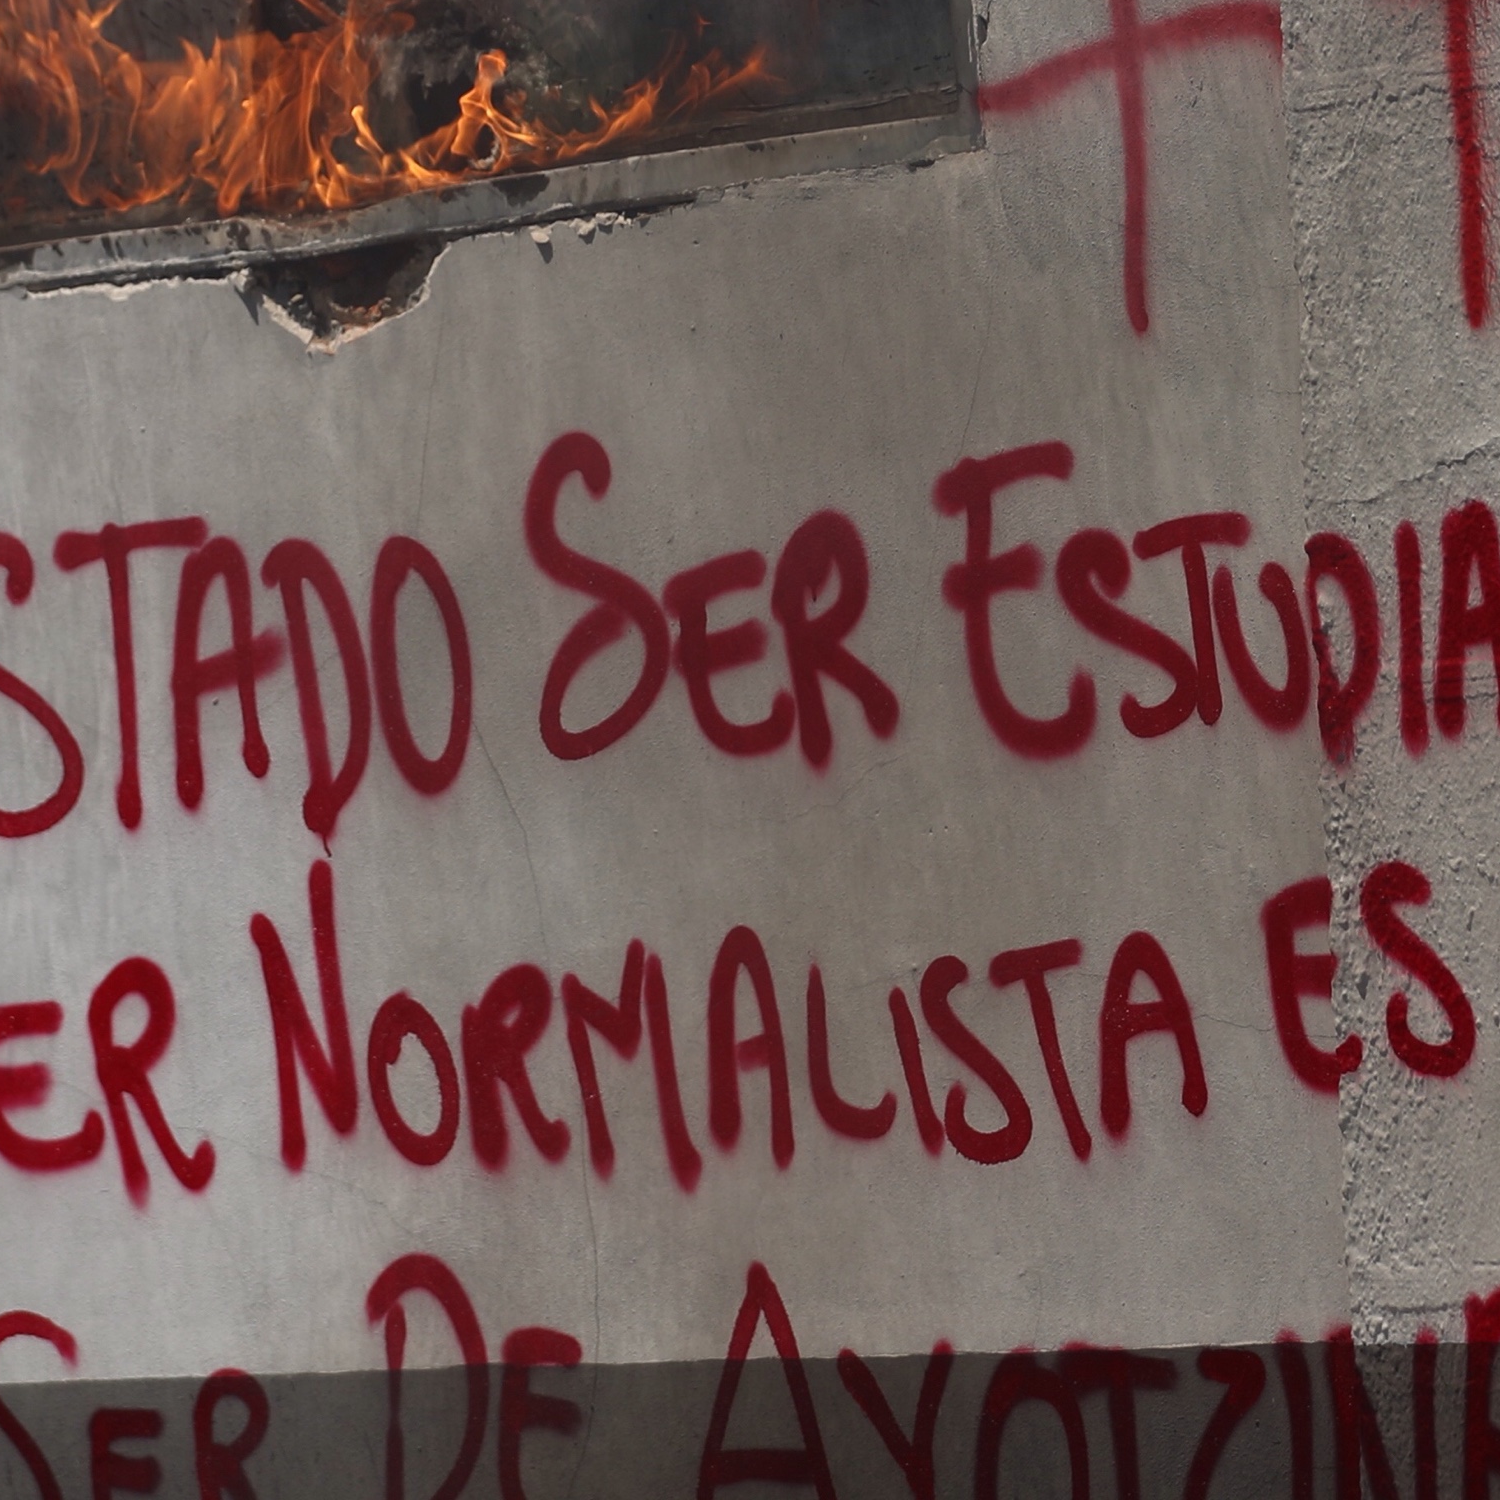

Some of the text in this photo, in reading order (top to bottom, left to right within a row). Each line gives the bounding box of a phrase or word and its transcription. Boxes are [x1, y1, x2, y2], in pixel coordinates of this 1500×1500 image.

[525, 432, 899, 772] SER
[248, 858, 1210, 1195] NORMALISTA
[1262, 860, 1477, 1098] ES
